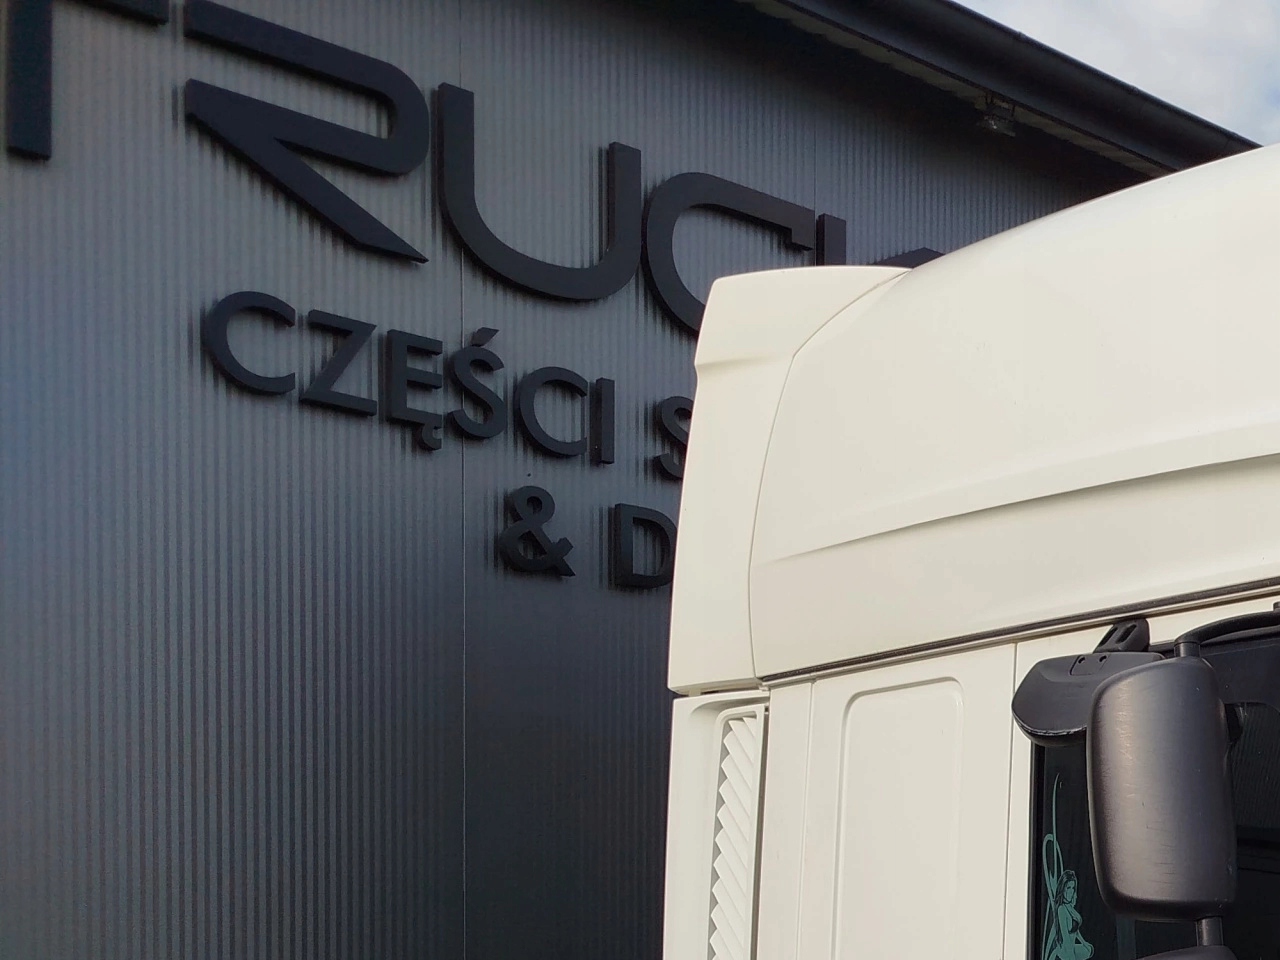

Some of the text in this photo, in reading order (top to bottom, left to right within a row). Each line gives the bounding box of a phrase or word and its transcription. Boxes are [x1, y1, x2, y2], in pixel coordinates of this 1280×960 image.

[7, 0, 947, 334] RUC
[204, 291, 616, 464] CZĘŚCI
[499, 485, 576, 577] &
